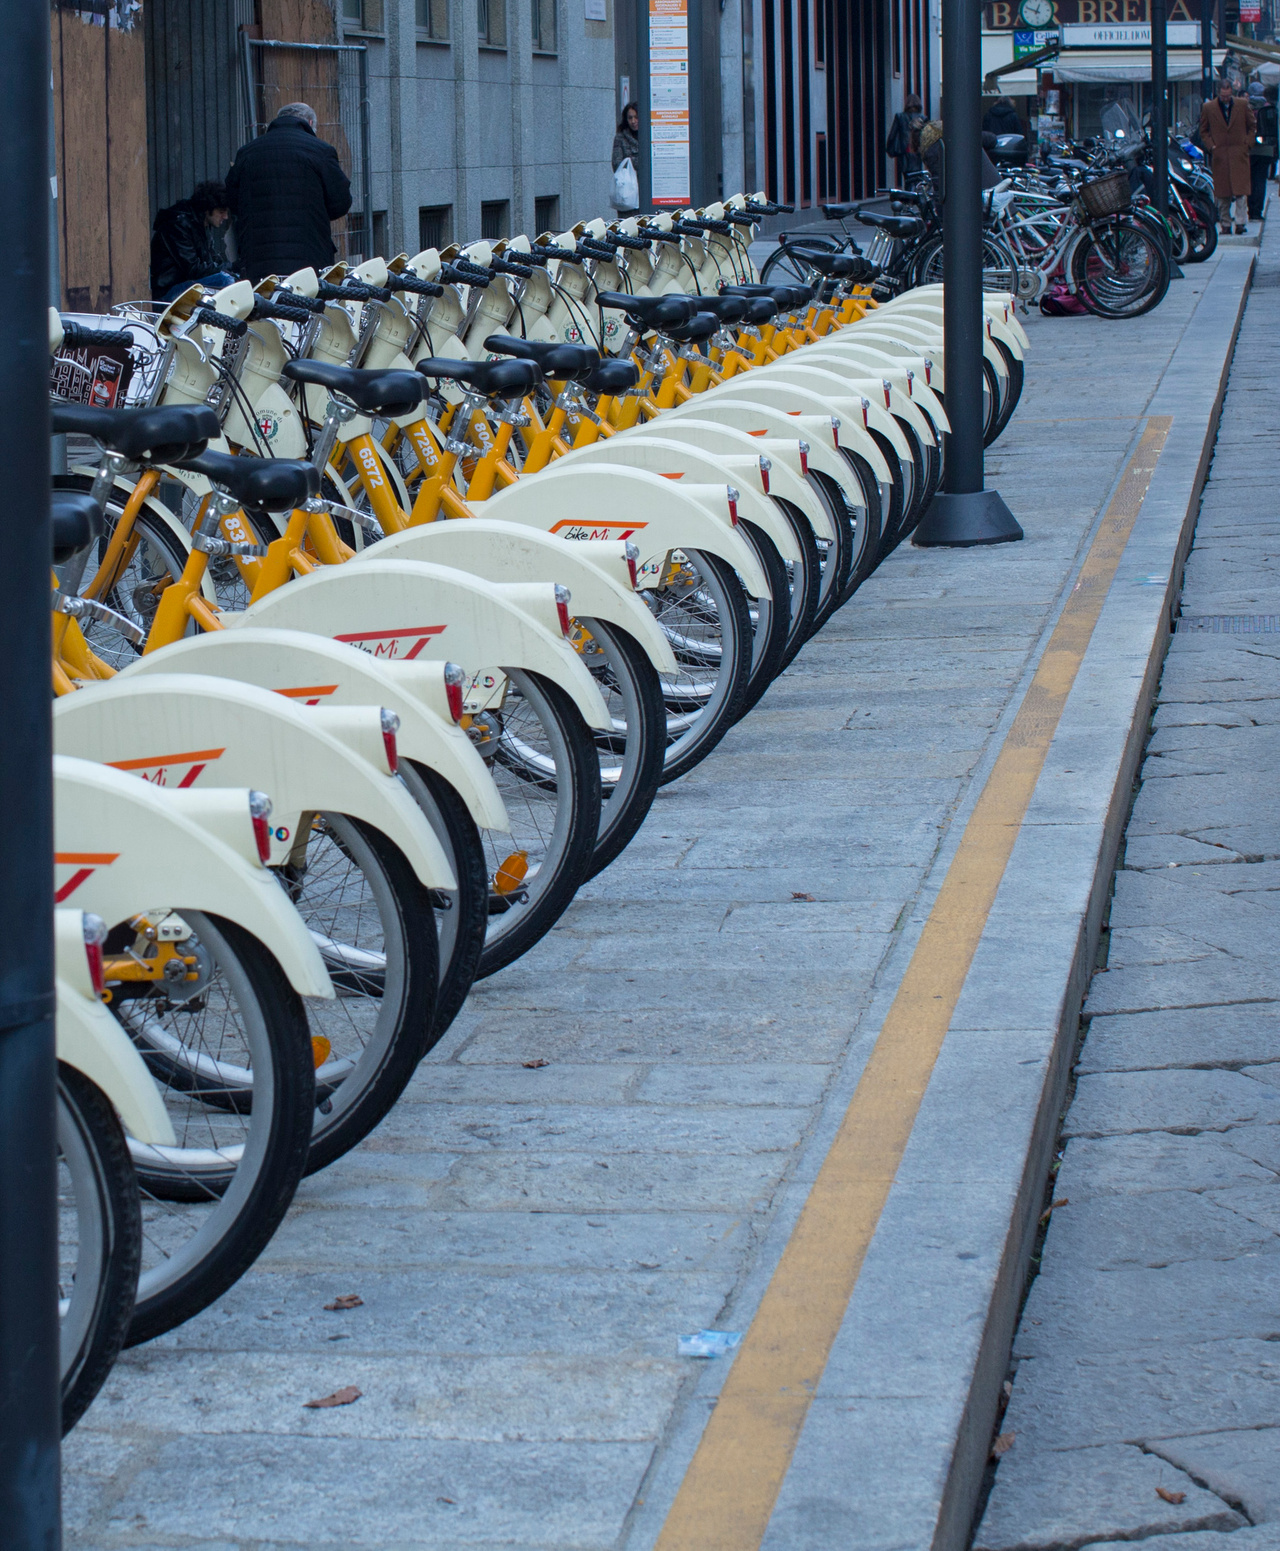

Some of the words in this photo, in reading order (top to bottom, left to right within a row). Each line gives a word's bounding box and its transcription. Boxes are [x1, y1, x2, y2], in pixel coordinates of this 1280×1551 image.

[1078, 0, 1193, 24] BREA
[413, 427, 439, 466] 7285
[359, 447, 384, 489] 6872
